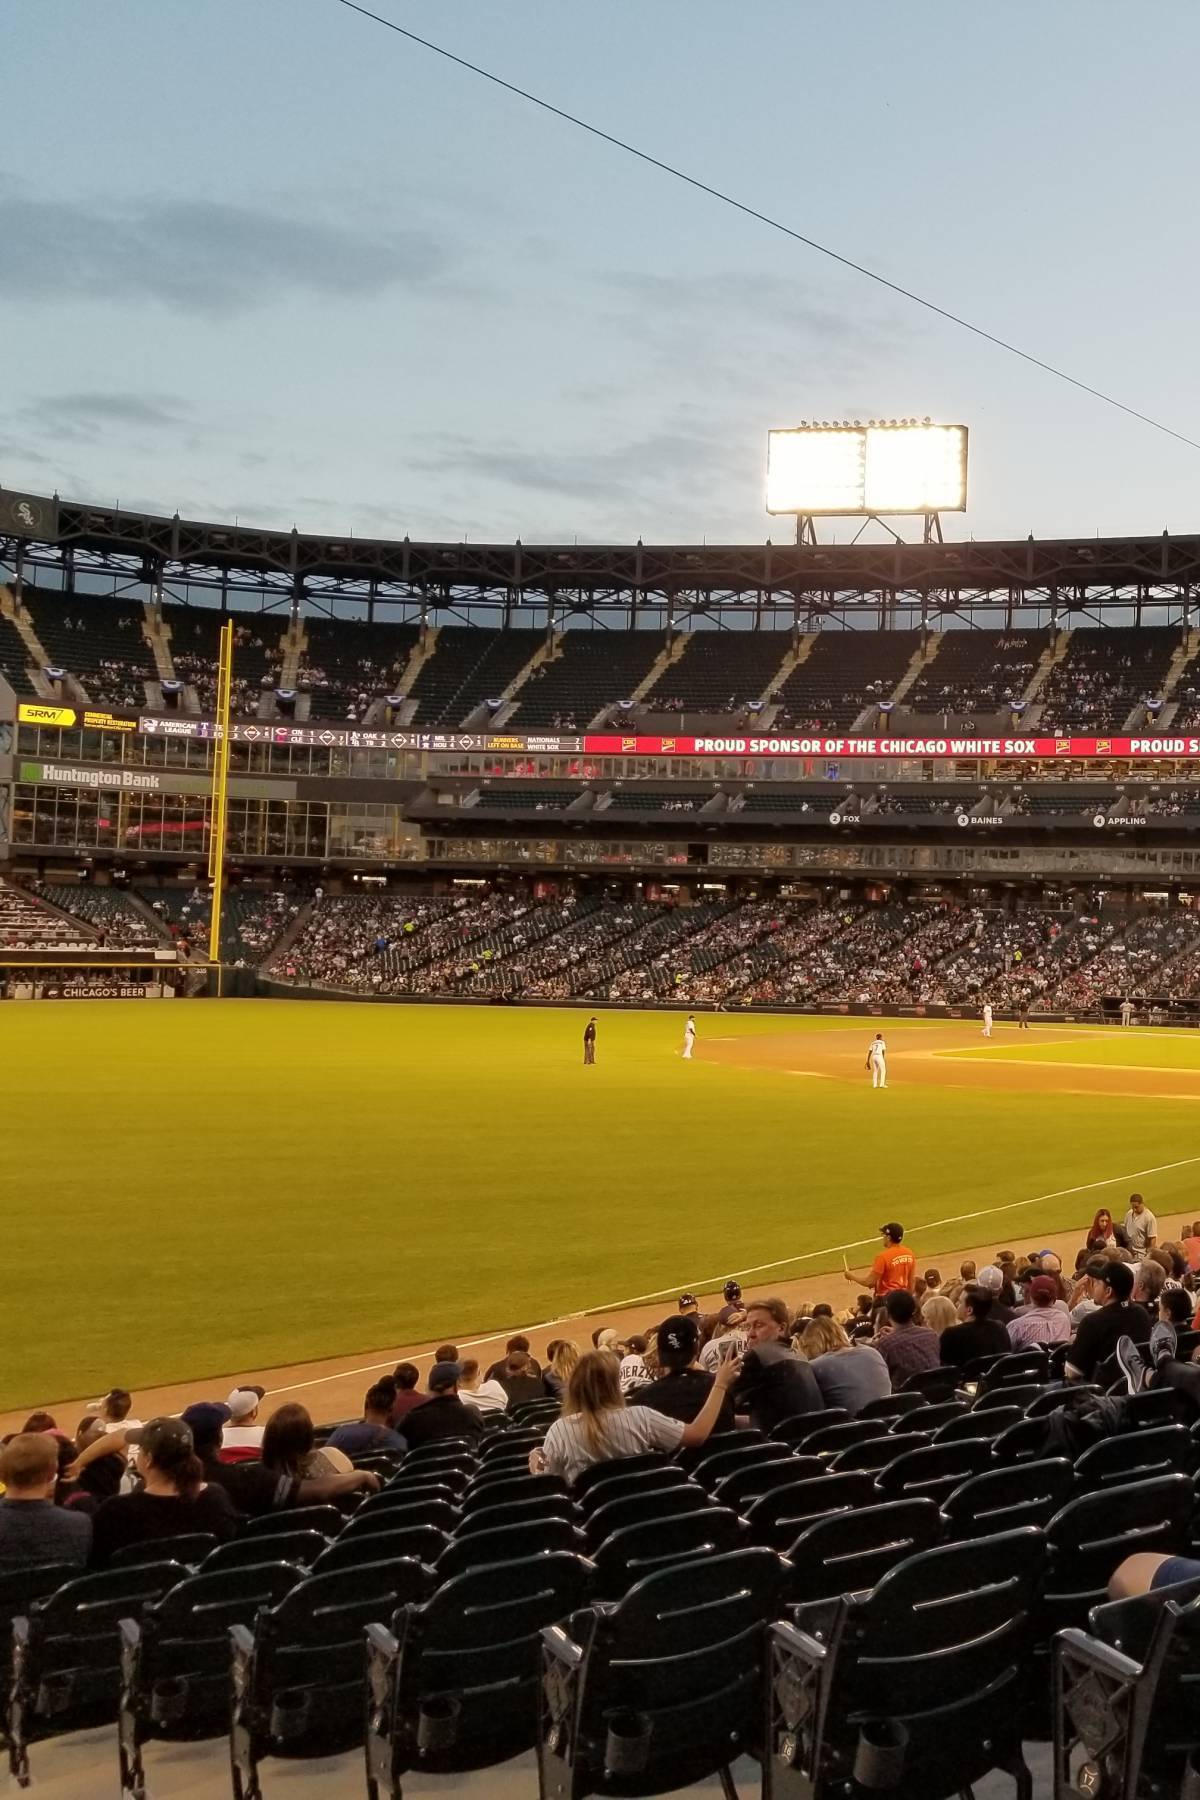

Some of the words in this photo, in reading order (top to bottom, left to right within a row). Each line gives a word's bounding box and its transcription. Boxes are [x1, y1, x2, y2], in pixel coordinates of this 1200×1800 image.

[26, 709, 56, 719] SRM
[159, 721, 197, 730] AMERICAN
[164, 727, 192, 735] LEAGUE
[694, 738, 746, 753] PROUD
[749, 739, 821, 753] SPONSOR
[824, 739, 845, 753] OF
[847, 739, 877, 753] THE
[880, 740, 947, 754] CHICAGO
[949, 740, 1001, 754] WHITE
[1004, 740, 1036, 754] SOX
[1130, 739, 1185, 753] PROUD
[42, 765, 121, 786] Huntington
[122, 773, 160, 788] Bank
[843, 815, 860, 823] FOX
[971, 817, 1003, 825] BAINES
[1107, 817, 1147, 825] APPLING
[63, 987, 118, 997] CHICAGO'S
[120, 987, 144, 997] BEER
